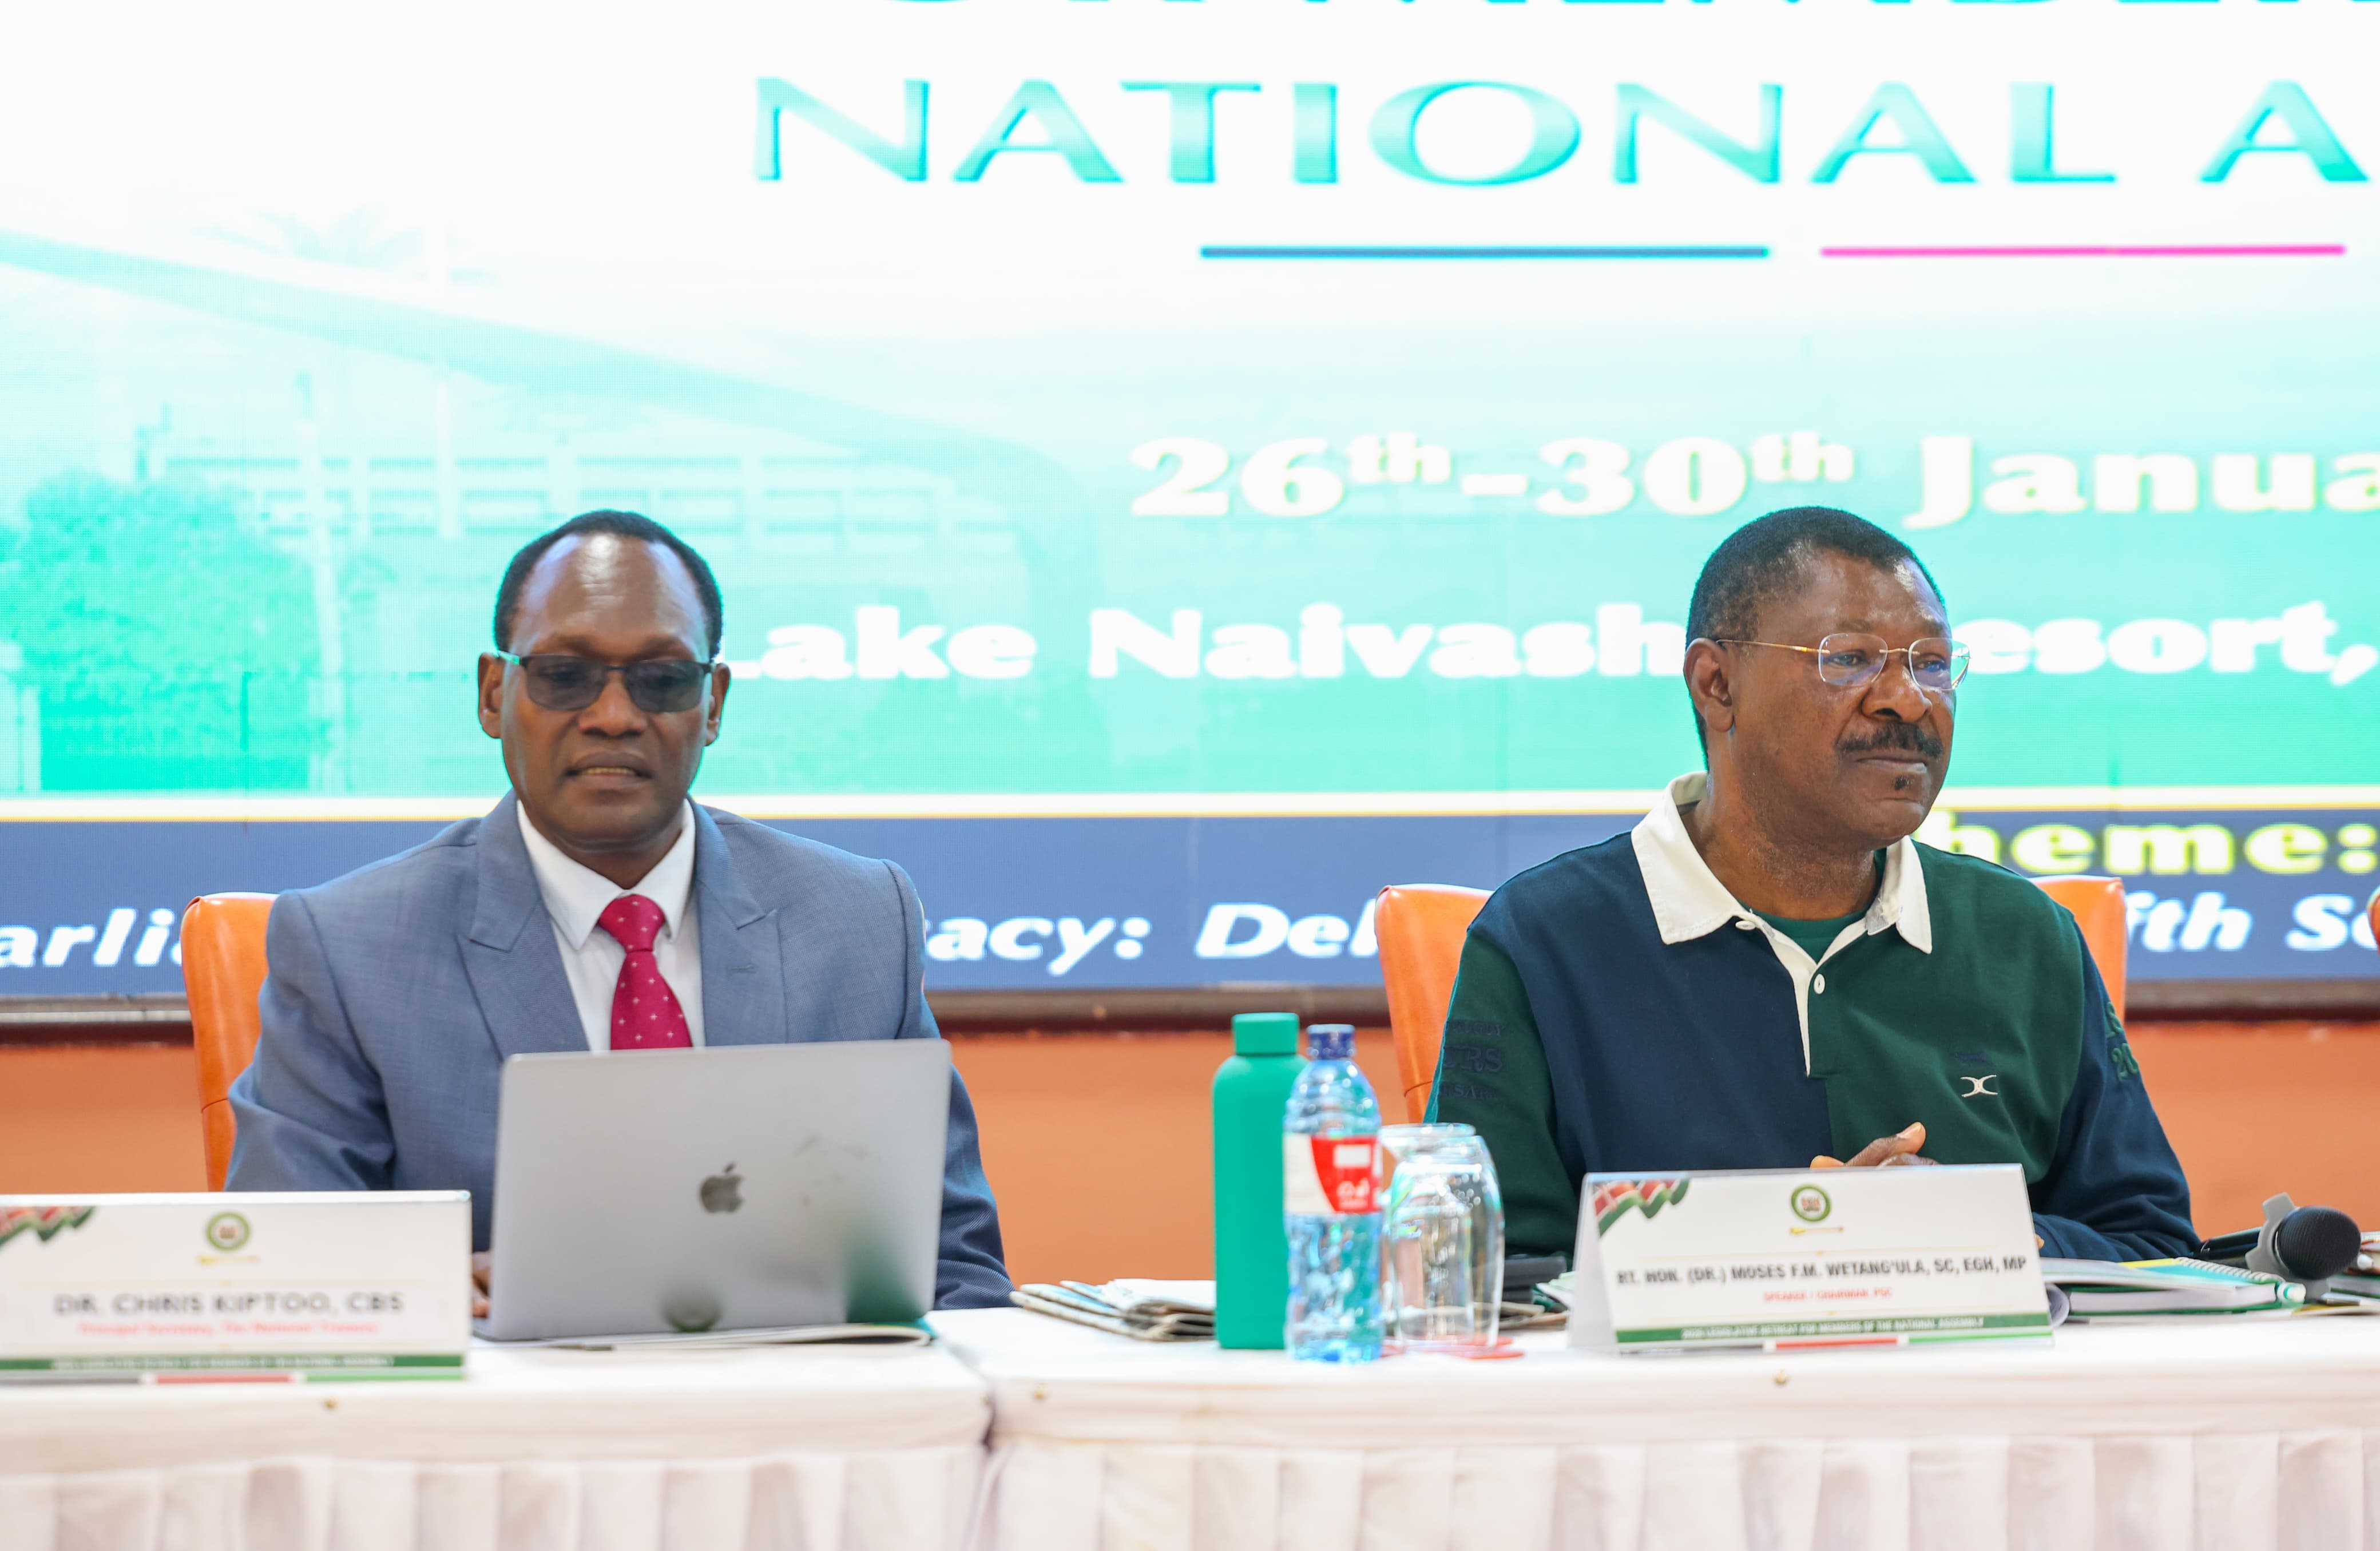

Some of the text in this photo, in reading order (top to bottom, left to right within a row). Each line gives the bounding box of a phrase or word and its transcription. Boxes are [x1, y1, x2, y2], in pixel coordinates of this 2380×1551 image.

[752, 77, 2370, 187] NATIONAL A
[0, 906, 181, 967] arli
[925, 916, 1151, 977] acy:
[1617, 1268, 1640, 1284] RT.
[1645, 1267, 1681, 1283] HON.
[1688, 1265, 1727, 1285] (DR.)
[1731, 1263, 1786, 1280] MOSES
[1791, 1262, 1822, 1278] F.M.
[1934, 1258, 1960, 1275] SC,
[1963, 1257, 2000, 1273] EGH,
[2004, 1255, 2027, 1271] MP
[112, 1293, 204, 1315] CHRIS
[213, 1291, 339, 1316] KIPTOO,
[346, 1291, 404, 1312] CBS
